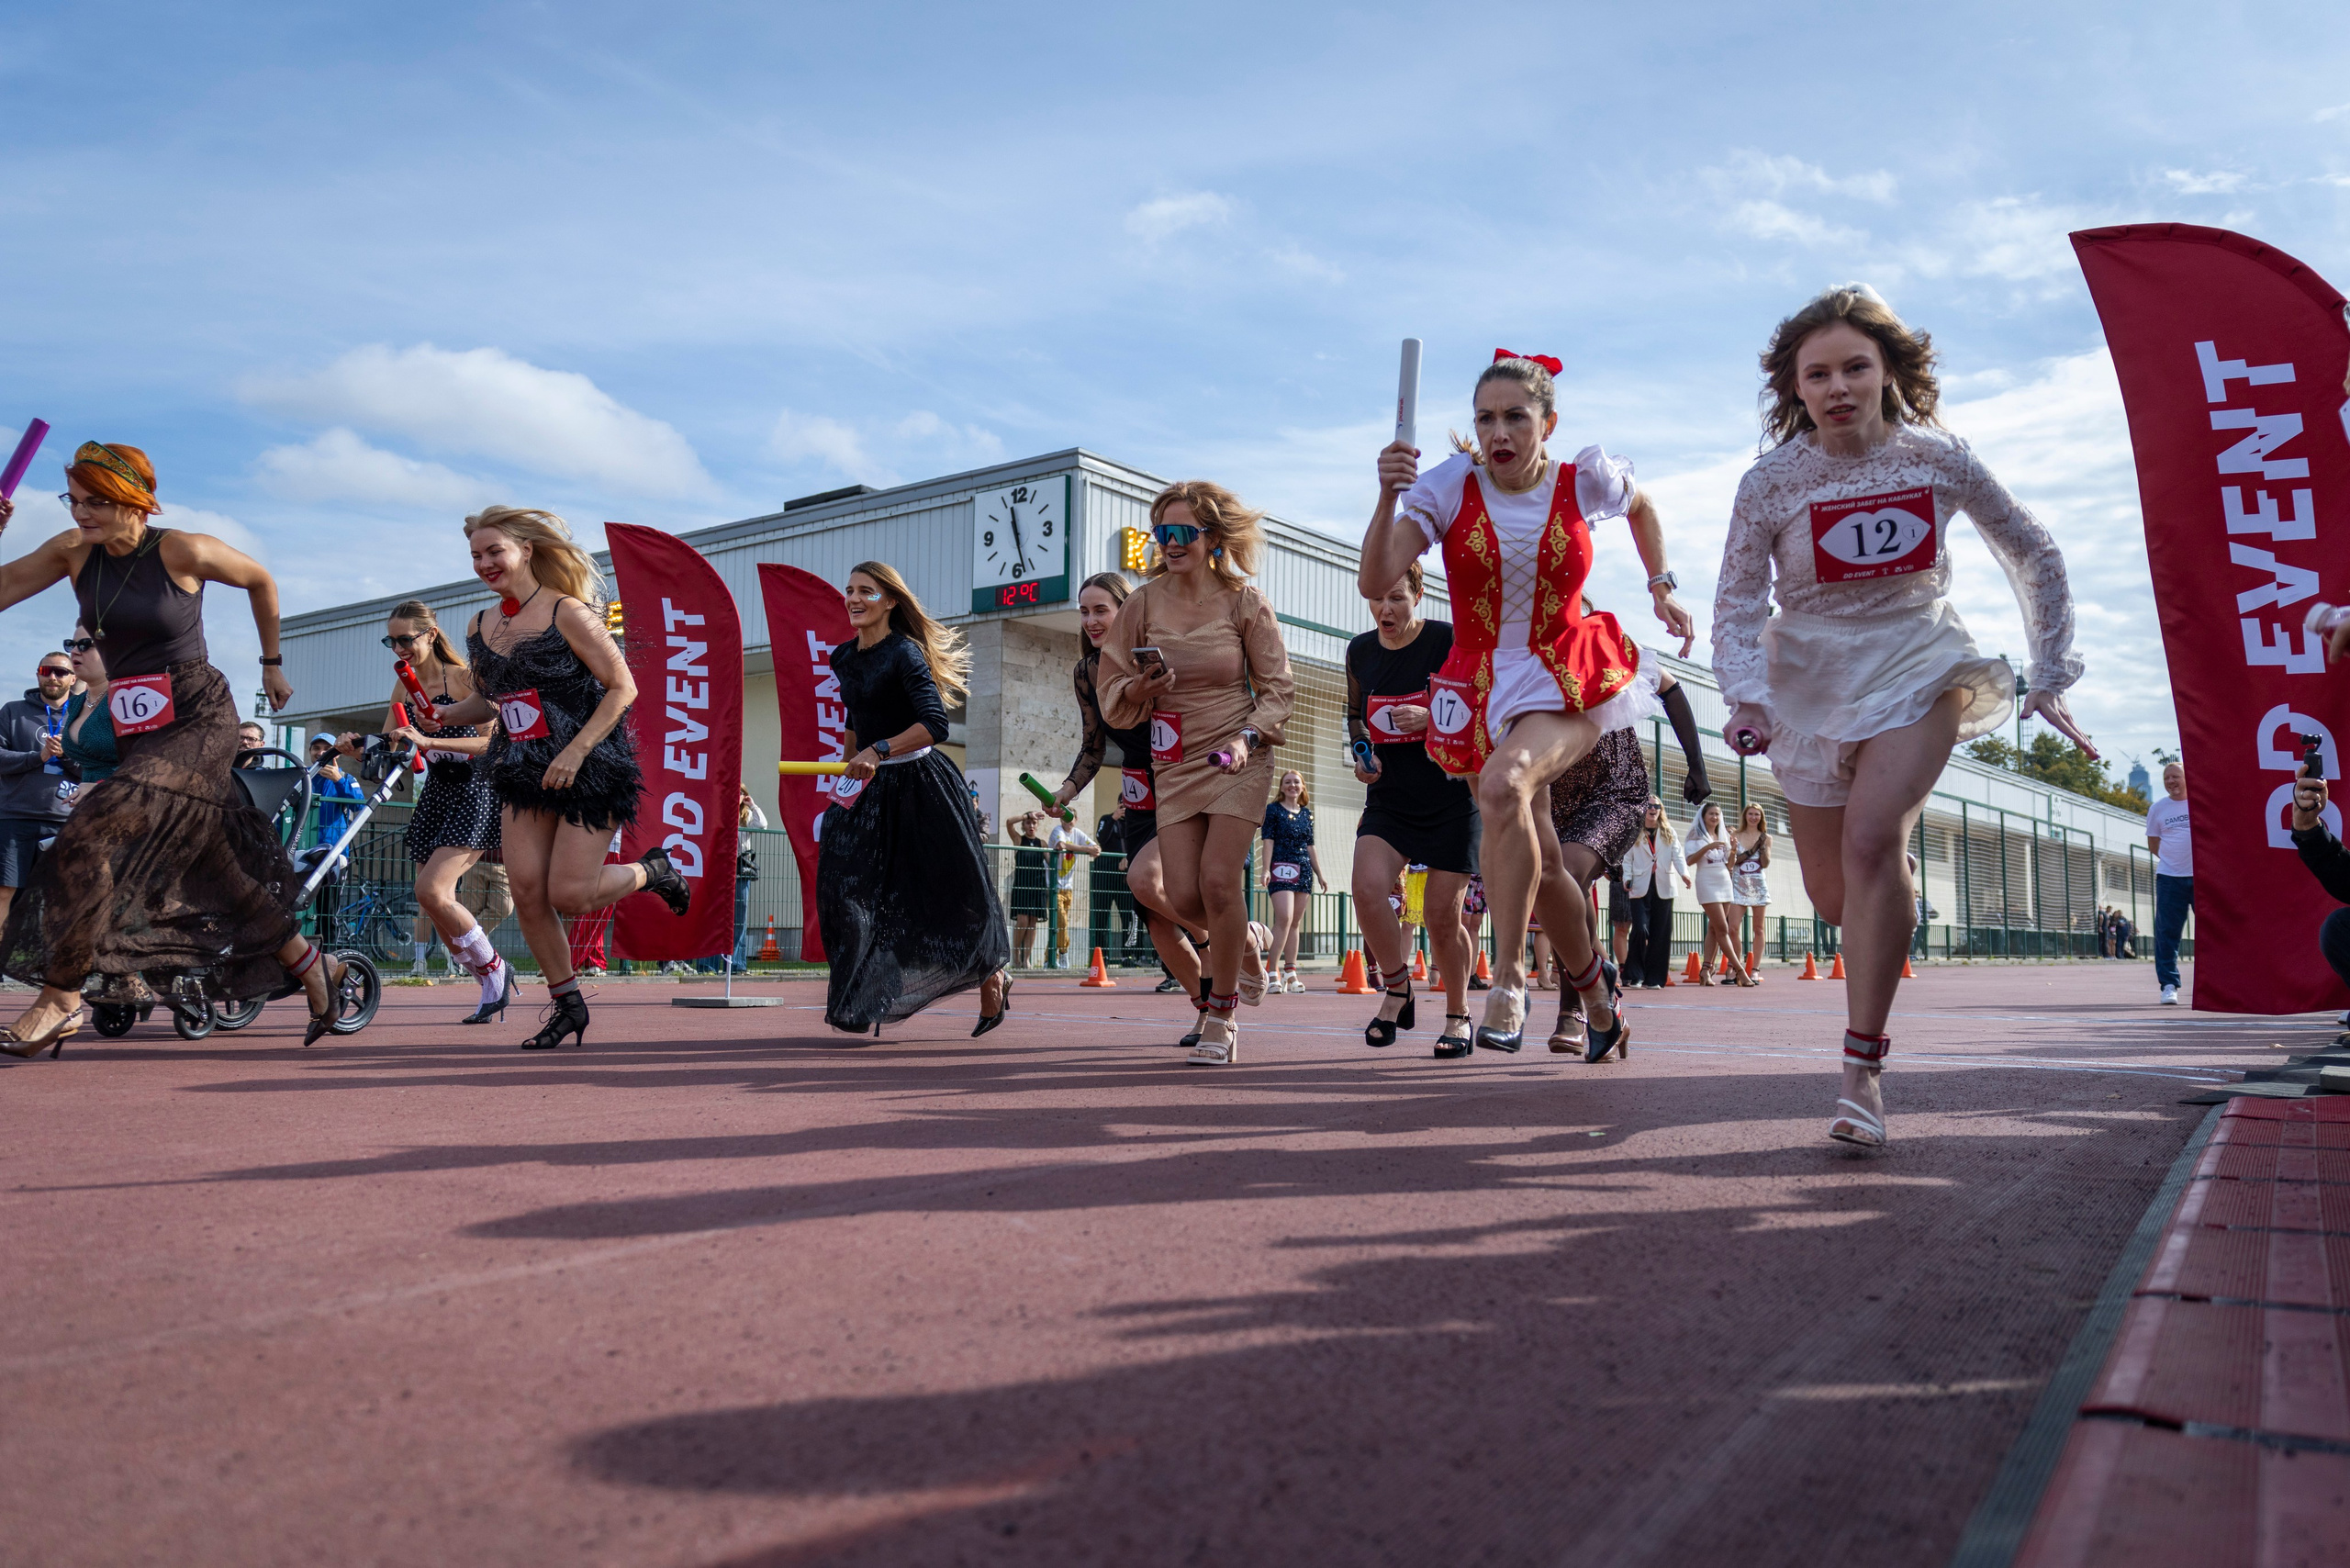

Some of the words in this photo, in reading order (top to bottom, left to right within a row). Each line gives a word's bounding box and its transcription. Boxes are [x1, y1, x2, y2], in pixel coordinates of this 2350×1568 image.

[1011, 487, 1028, 504] 12
[1821, 501, 1855, 512] ЖЕНСКИЙ
[1856, 499, 1876, 508] ЗАБЕГ
[1888, 492, 1923, 503] КАБЛУКАХ
[2195, 340, 2326, 675] EVENT
[983, 531, 994, 547] 9
[1042, 521, 1053, 537] 3
[1850, 518, 1902, 558] 12
[1910, 528, 1916, 538] 1
[1012, 563, 1023, 579] 6
[1002, 587, 1017, 606] 12
[661, 597, 710, 780] EVENT
[119, 692, 149, 720] 16
[1438, 697, 1457, 727] 17
[1460, 711, 1464, 720] 1
[505, 707, 524, 729] 11
[1151, 723, 1165, 747] 21
[2257, 703, 2343, 849] DD
[1123, 778, 1138, 800] 14
[661, 791, 704, 878] DD
[1281, 868, 1292, 878] 14
